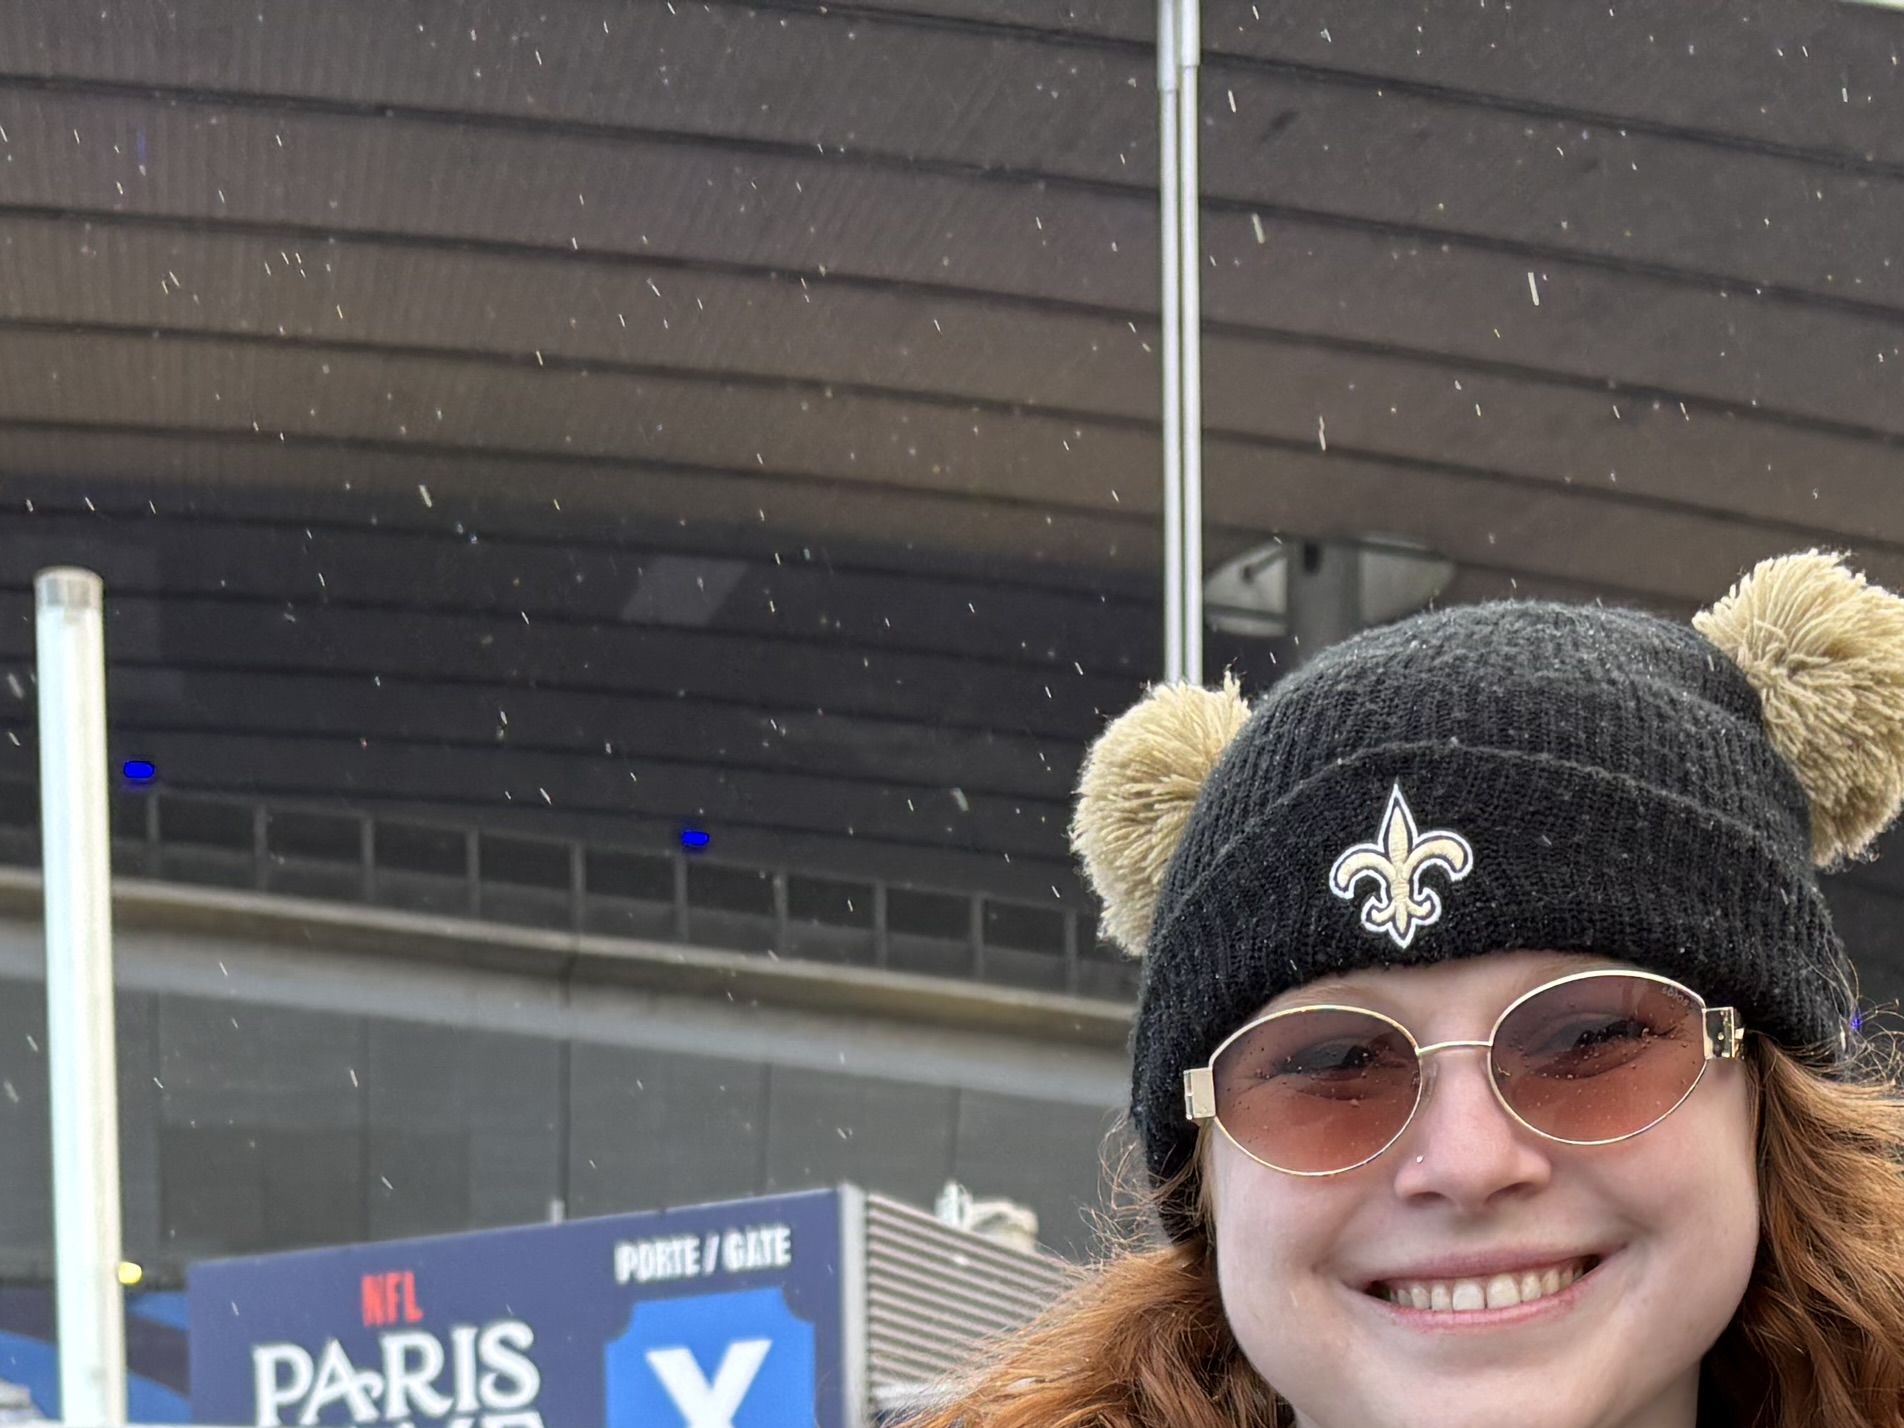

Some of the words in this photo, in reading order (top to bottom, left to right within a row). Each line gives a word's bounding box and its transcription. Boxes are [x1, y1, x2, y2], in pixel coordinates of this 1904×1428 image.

[615, 1235, 701, 1285] PORTE
[723, 1223, 792, 1273] GATE
[360, 1270, 423, 1327] NFL
